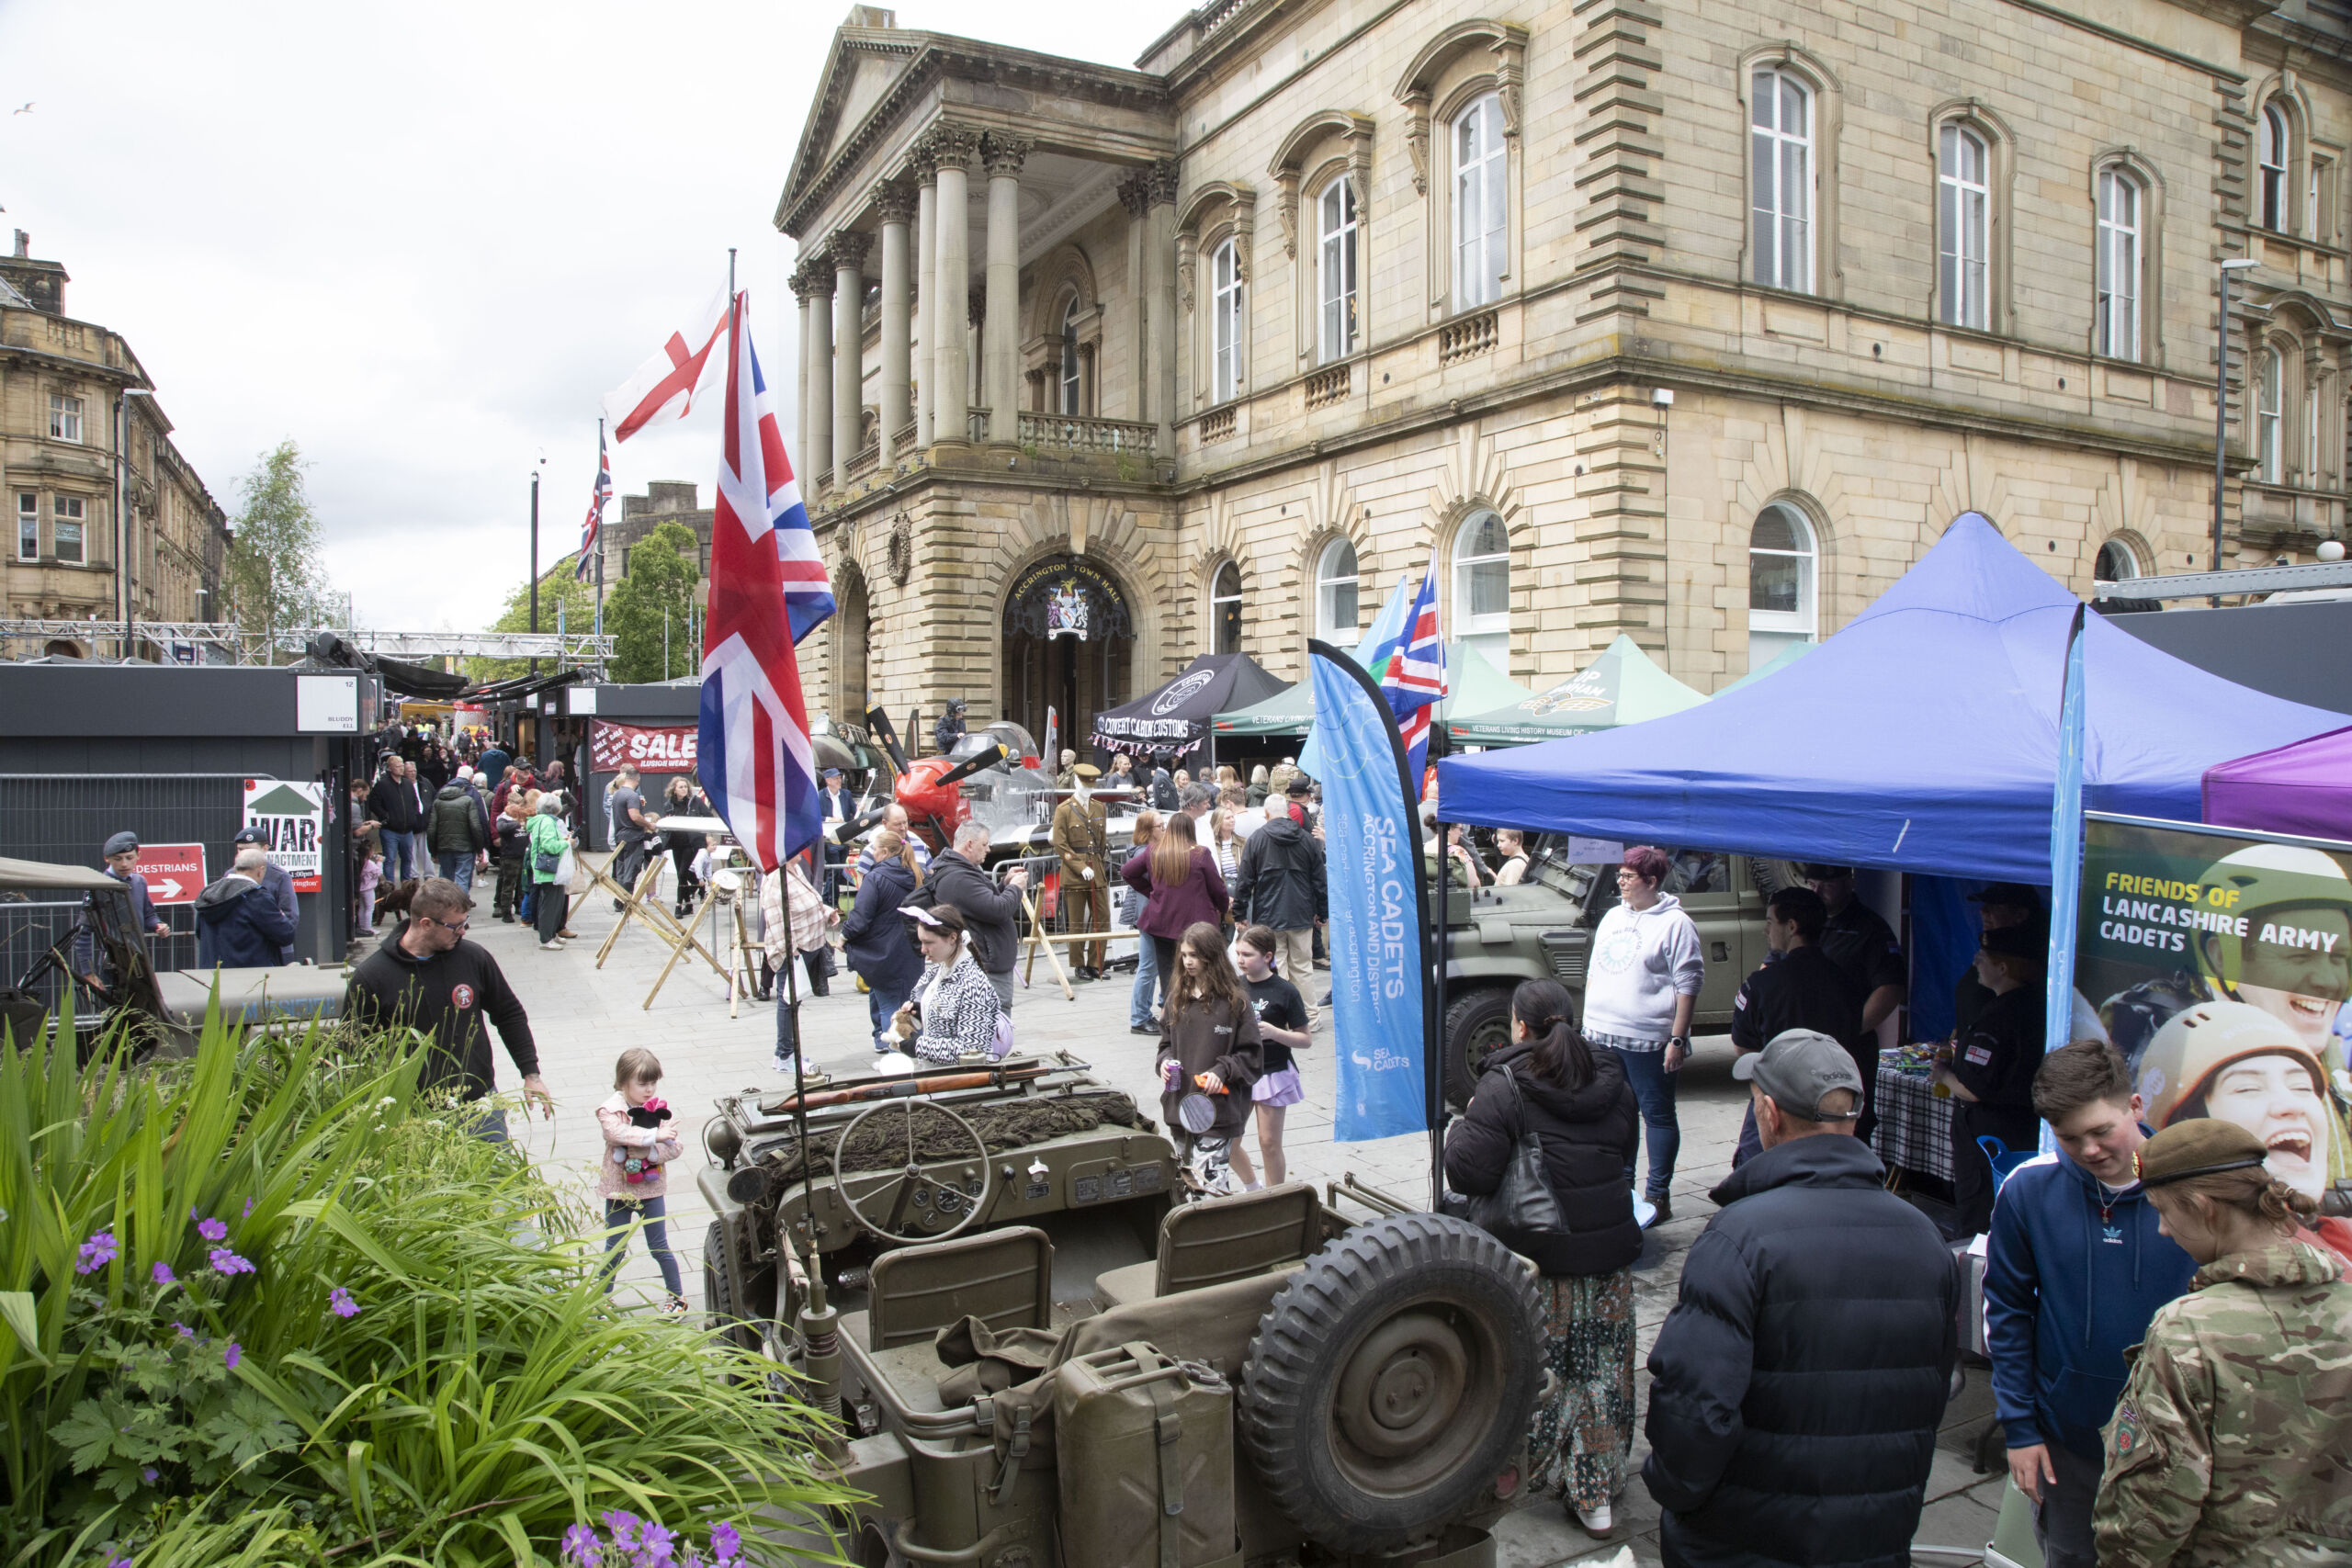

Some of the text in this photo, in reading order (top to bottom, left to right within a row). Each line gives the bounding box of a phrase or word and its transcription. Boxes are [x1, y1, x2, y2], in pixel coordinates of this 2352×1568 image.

[1014, 563, 1122, 604] ACCRINGTON TOWN HALL
[1104, 717, 1131, 735] COVERT
[1130, 717, 1154, 737] CABIN
[1154, 719, 1189, 738] CUSTOMS
[1252, 715, 1283, 724] VETERANS
[594, 727, 609, 739] SALE
[609, 728, 624, 740] SALE
[1472, 725, 1500, 733] VETERANS
[1501, 726, 1520, 734] LIVING
[1521, 726, 1545, 735] HISTORY
[1546, 728, 1572, 736] MUSEUM
[593, 739, 607, 751] SALE
[612, 739, 627, 751] SALE
[629, 734, 698, 759] SALE
[595, 750, 610, 762] SALE
[608, 752, 623, 765] SALE
[133, 863, 198, 874] DESTRIANS
[1363, 812, 1377, 917] ACCRINGTON
[2105, 872, 2240, 908] FRIENDS OF
[1374, 817, 1405, 999] SEA CADETS
[2102, 896, 2339, 953] LANCASHIRE ARMY
[1367, 919, 1378, 953] AND
[2099, 920, 2186, 952] CADETS
[1374, 1047, 1410, 1071] SEA CADETS
[1823, 1071, 1852, 1081] adidas
